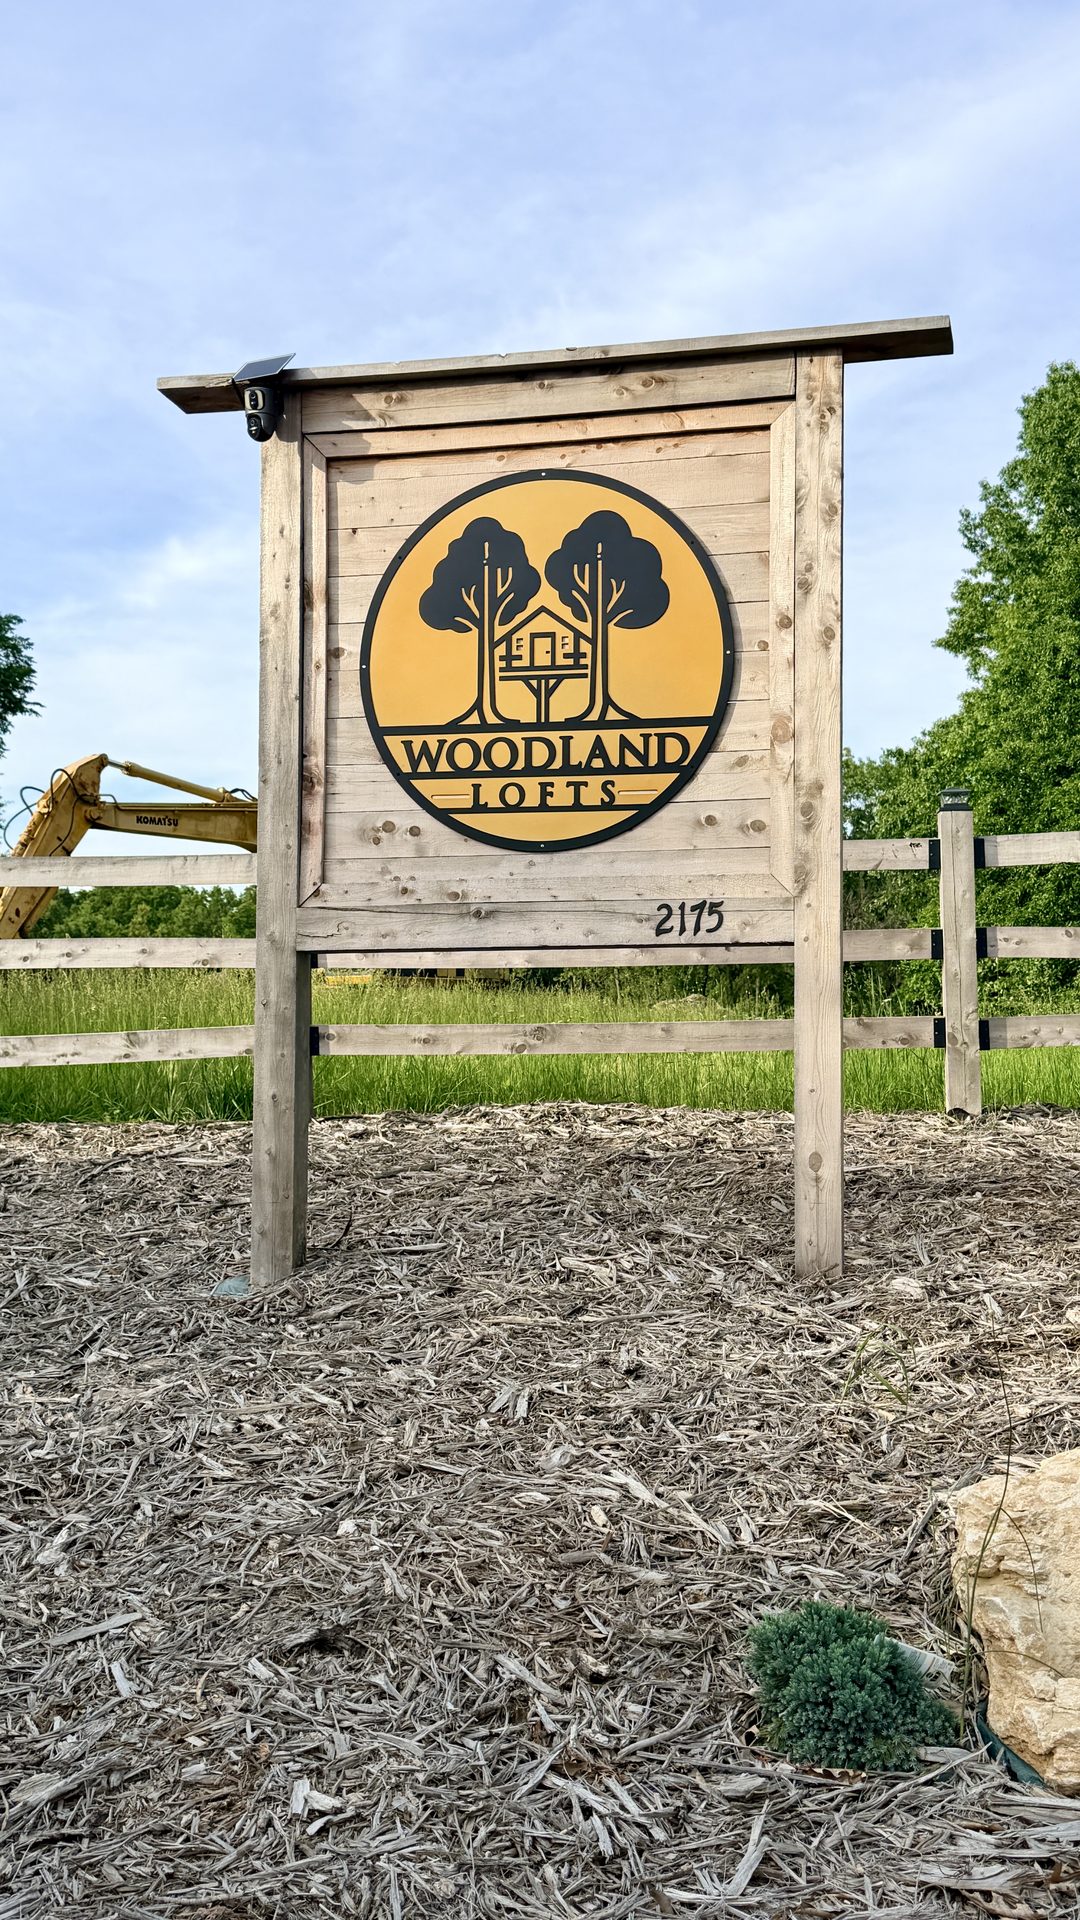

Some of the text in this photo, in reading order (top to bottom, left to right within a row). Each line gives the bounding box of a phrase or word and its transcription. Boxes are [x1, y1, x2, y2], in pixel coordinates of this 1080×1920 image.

[400, 731, 691, 772] WOODLAND
[470, 780, 617, 808] LOFTS
[135, 815, 179, 827] KOMATSU
[655, 899, 724, 937] 2175
